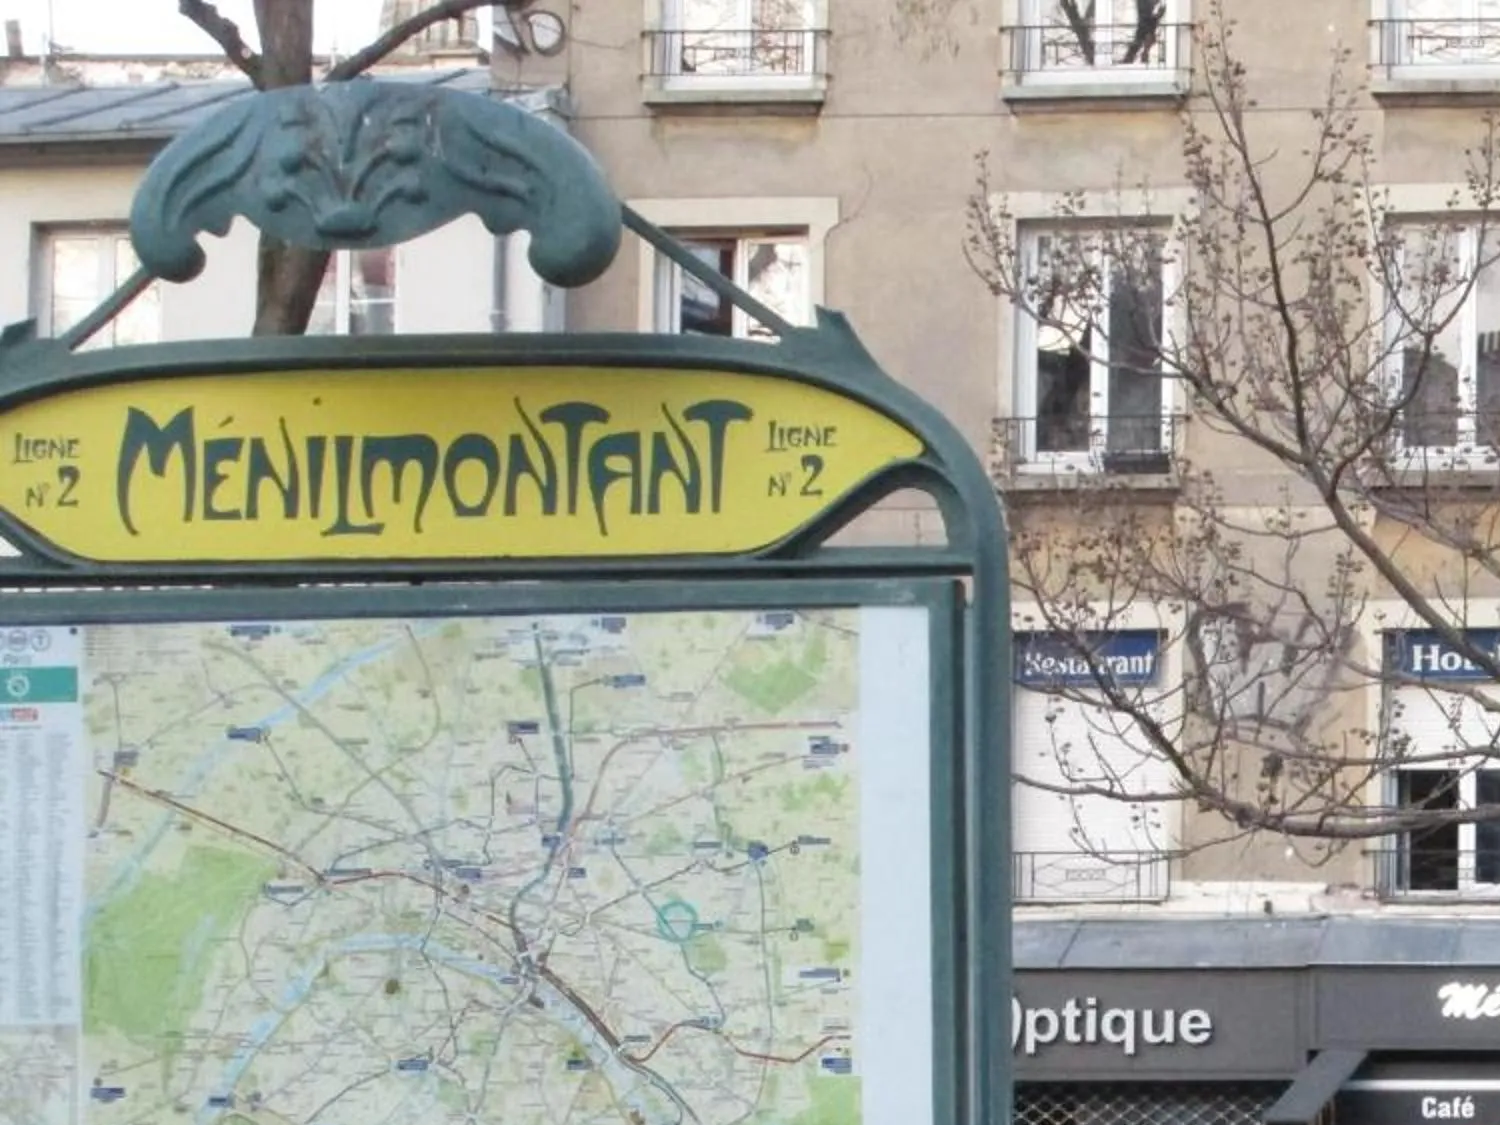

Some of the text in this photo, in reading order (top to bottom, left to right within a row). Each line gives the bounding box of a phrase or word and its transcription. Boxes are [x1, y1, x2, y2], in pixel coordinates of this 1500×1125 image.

[13, 433, 81, 464] LIGNE
[764, 420, 837, 453] LIGNE
[117, 397, 753, 537] MÉNILMONTANT
[800, 454, 824, 496] 2
[57, 465, 80, 507] 2
[1421, 1095, 1475, 1119] Café
